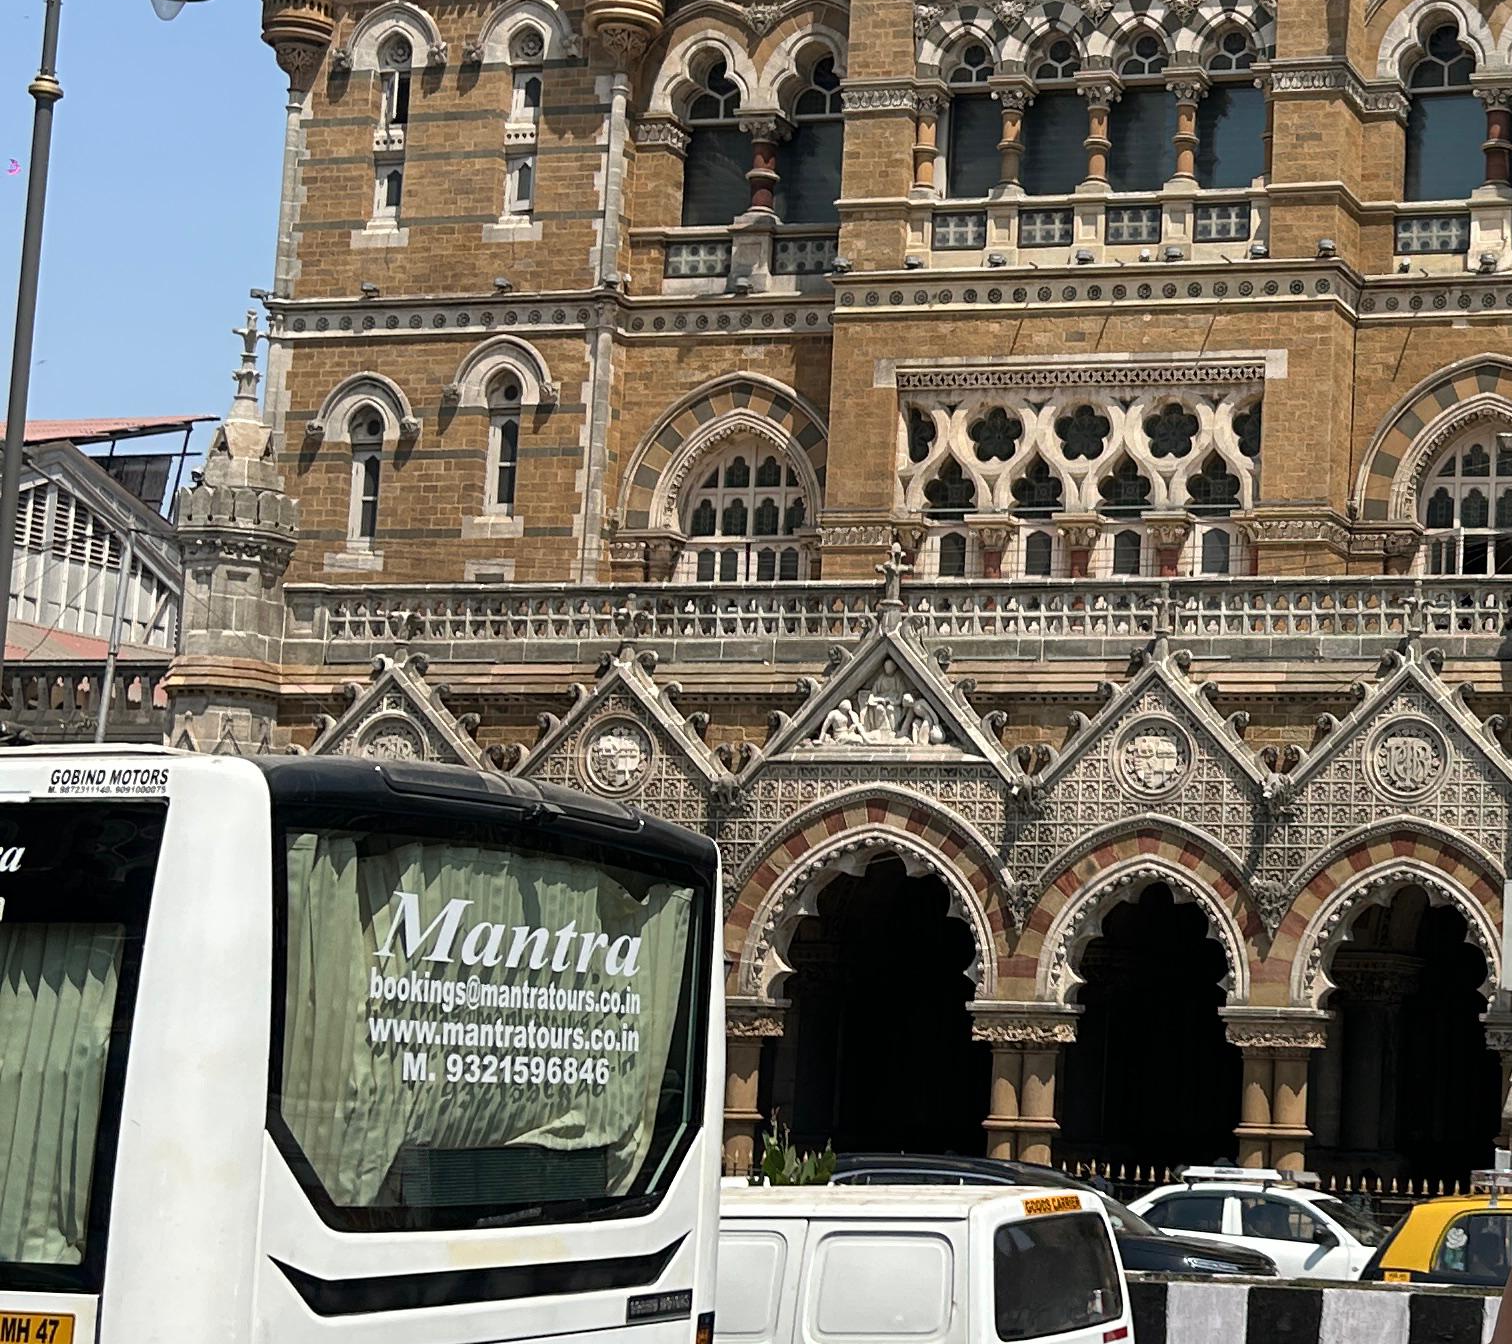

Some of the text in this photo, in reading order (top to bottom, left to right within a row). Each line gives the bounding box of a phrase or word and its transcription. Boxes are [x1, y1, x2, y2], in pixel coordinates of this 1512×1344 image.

[51, 768, 169, 785] GOBIND MOTORS
[373, 891, 641, 977] Mantra
[369, 967, 641, 1014] bookings@mantratours.co.in
[369, 1017, 640, 1052] www.mantratours.co.in
[402, 1053, 610, 1084] M. 9321596846
[1, 1317, 60, 1344] MH 47
